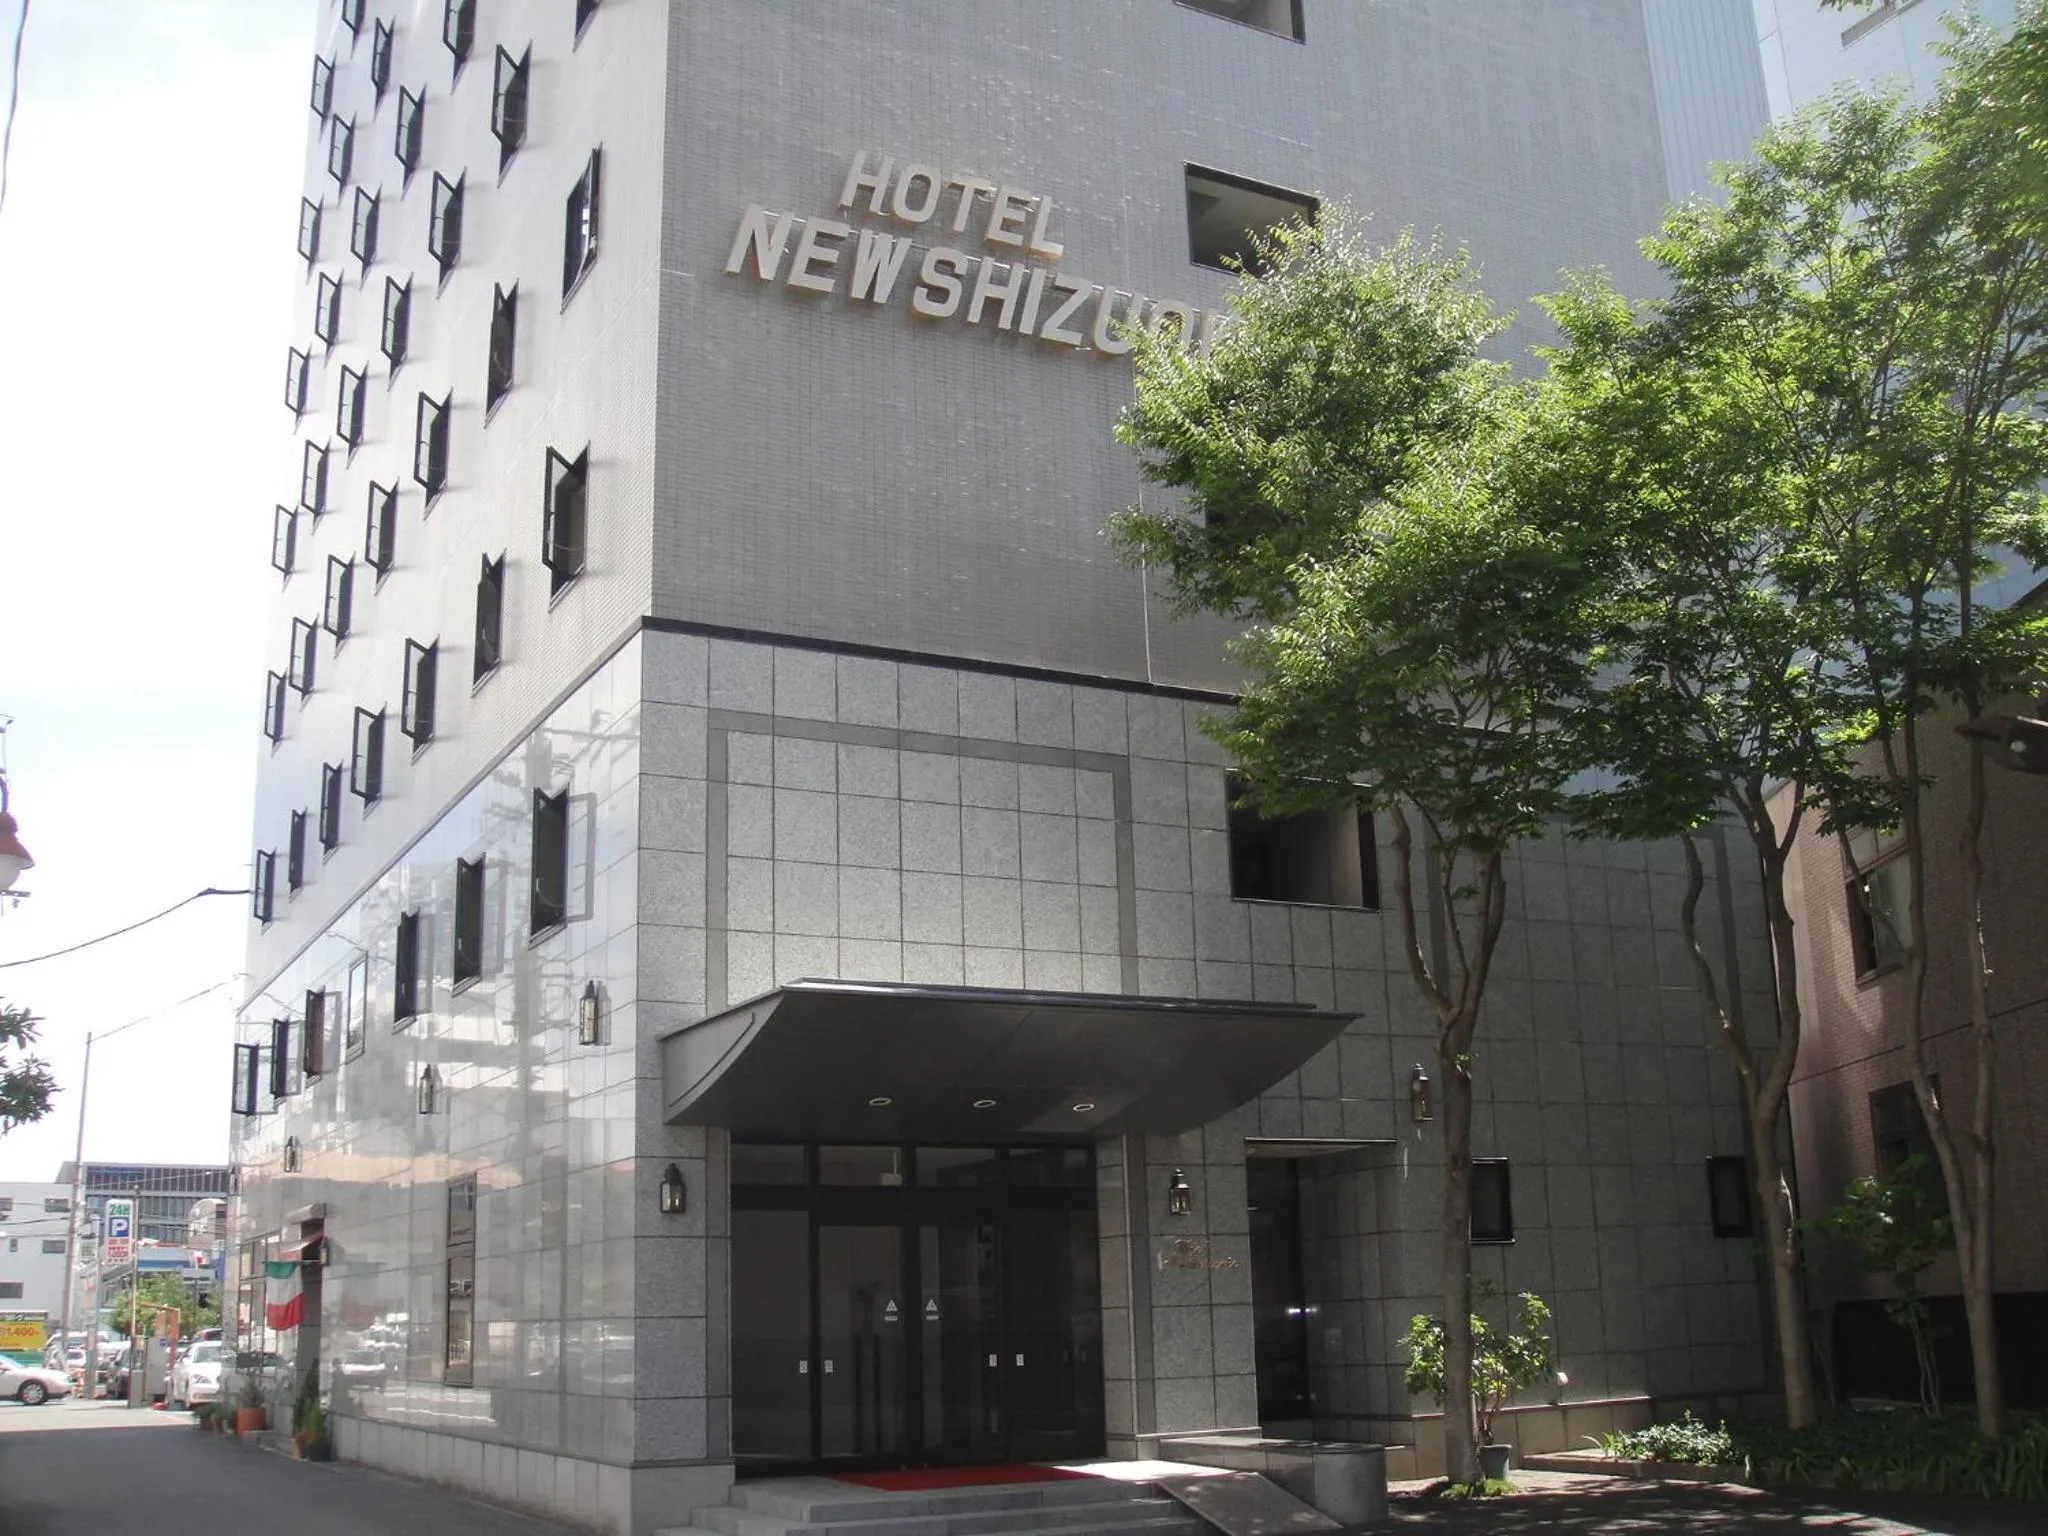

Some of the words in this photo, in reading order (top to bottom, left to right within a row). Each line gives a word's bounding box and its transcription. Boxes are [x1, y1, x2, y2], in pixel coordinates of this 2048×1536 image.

[724, 203, 913, 304] NEW
[839, 150, 1064, 258] HOTEL
[111, 1218, 128, 1237] P
